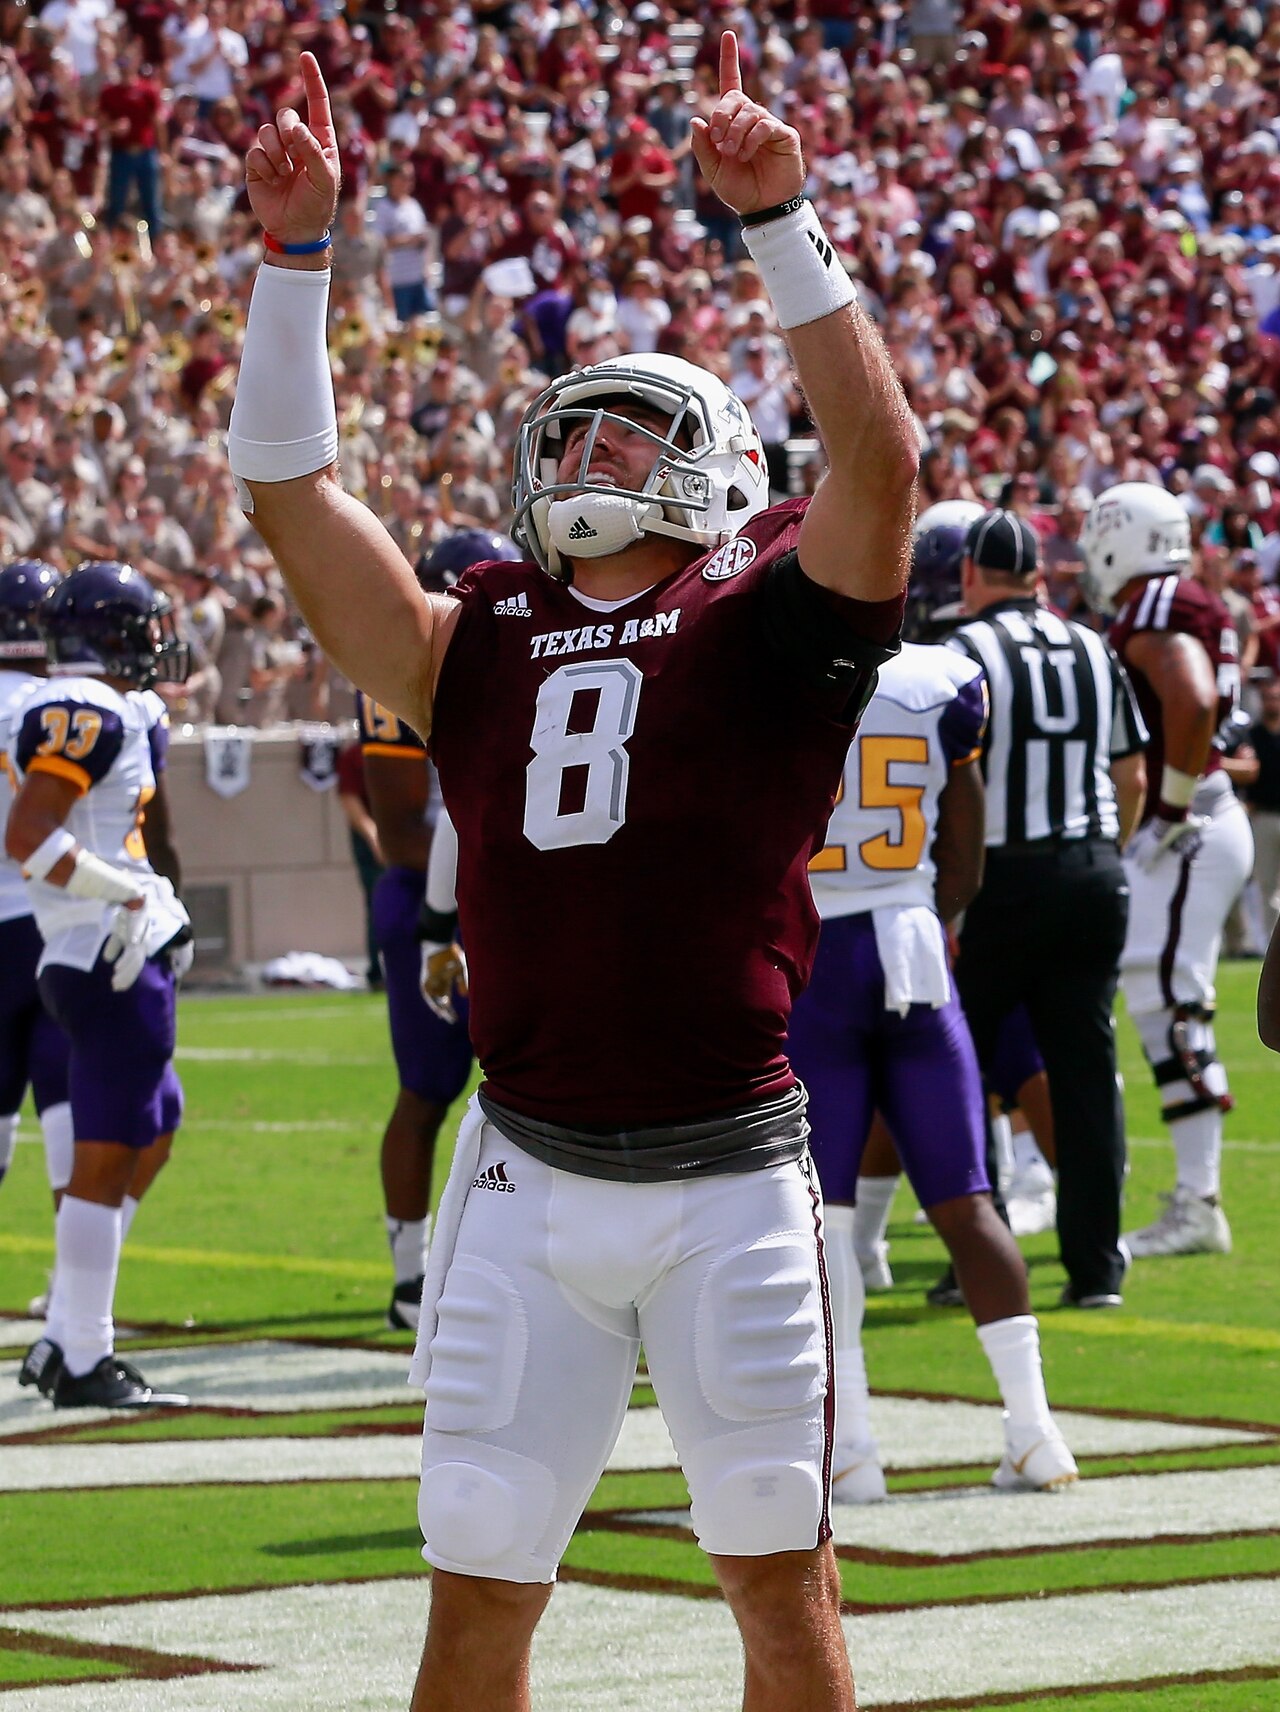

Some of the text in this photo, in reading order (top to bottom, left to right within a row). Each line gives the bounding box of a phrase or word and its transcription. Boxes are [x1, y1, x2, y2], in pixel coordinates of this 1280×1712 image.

[568, 528, 598, 540] adidas
[706, 541, 749, 577] SEC
[493, 605, 533, 618] didas
[529, 608, 682, 660] TEXAS A&M
[1019, 645, 1080, 734] U
[36, 706, 103, 760] 33
[522, 657, 644, 852] 8
